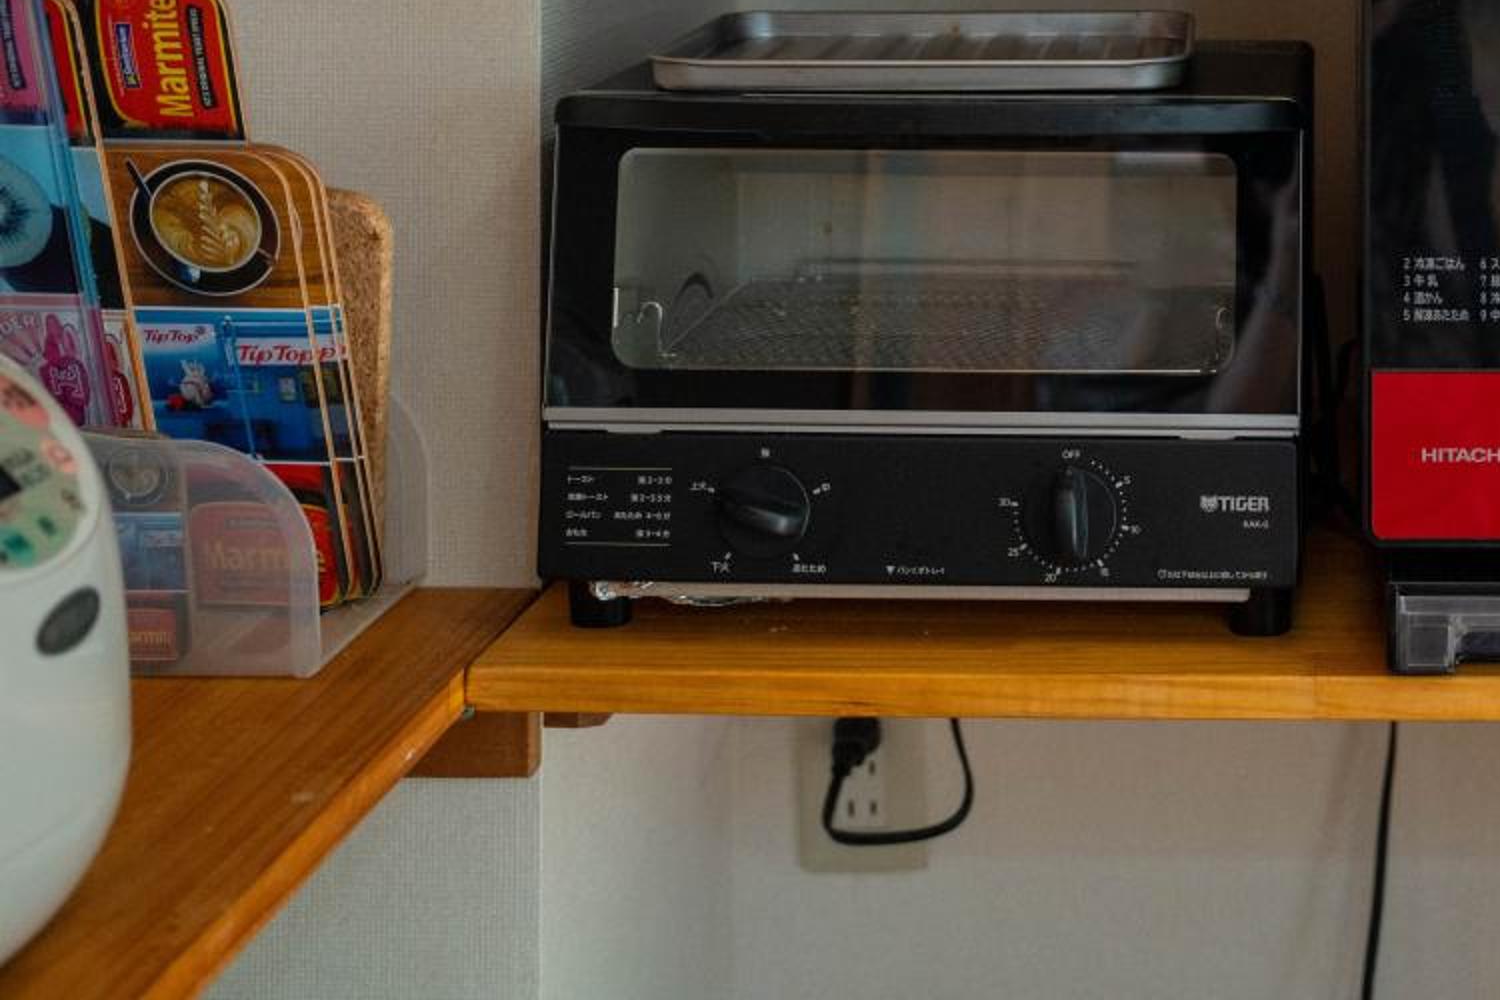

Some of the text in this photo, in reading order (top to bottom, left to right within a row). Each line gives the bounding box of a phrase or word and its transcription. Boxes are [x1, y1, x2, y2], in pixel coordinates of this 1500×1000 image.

[143, 329, 200, 344] TipTop
[1061, 449, 1081, 459] OFF
[1219, 495, 1270, 512] TIGER
